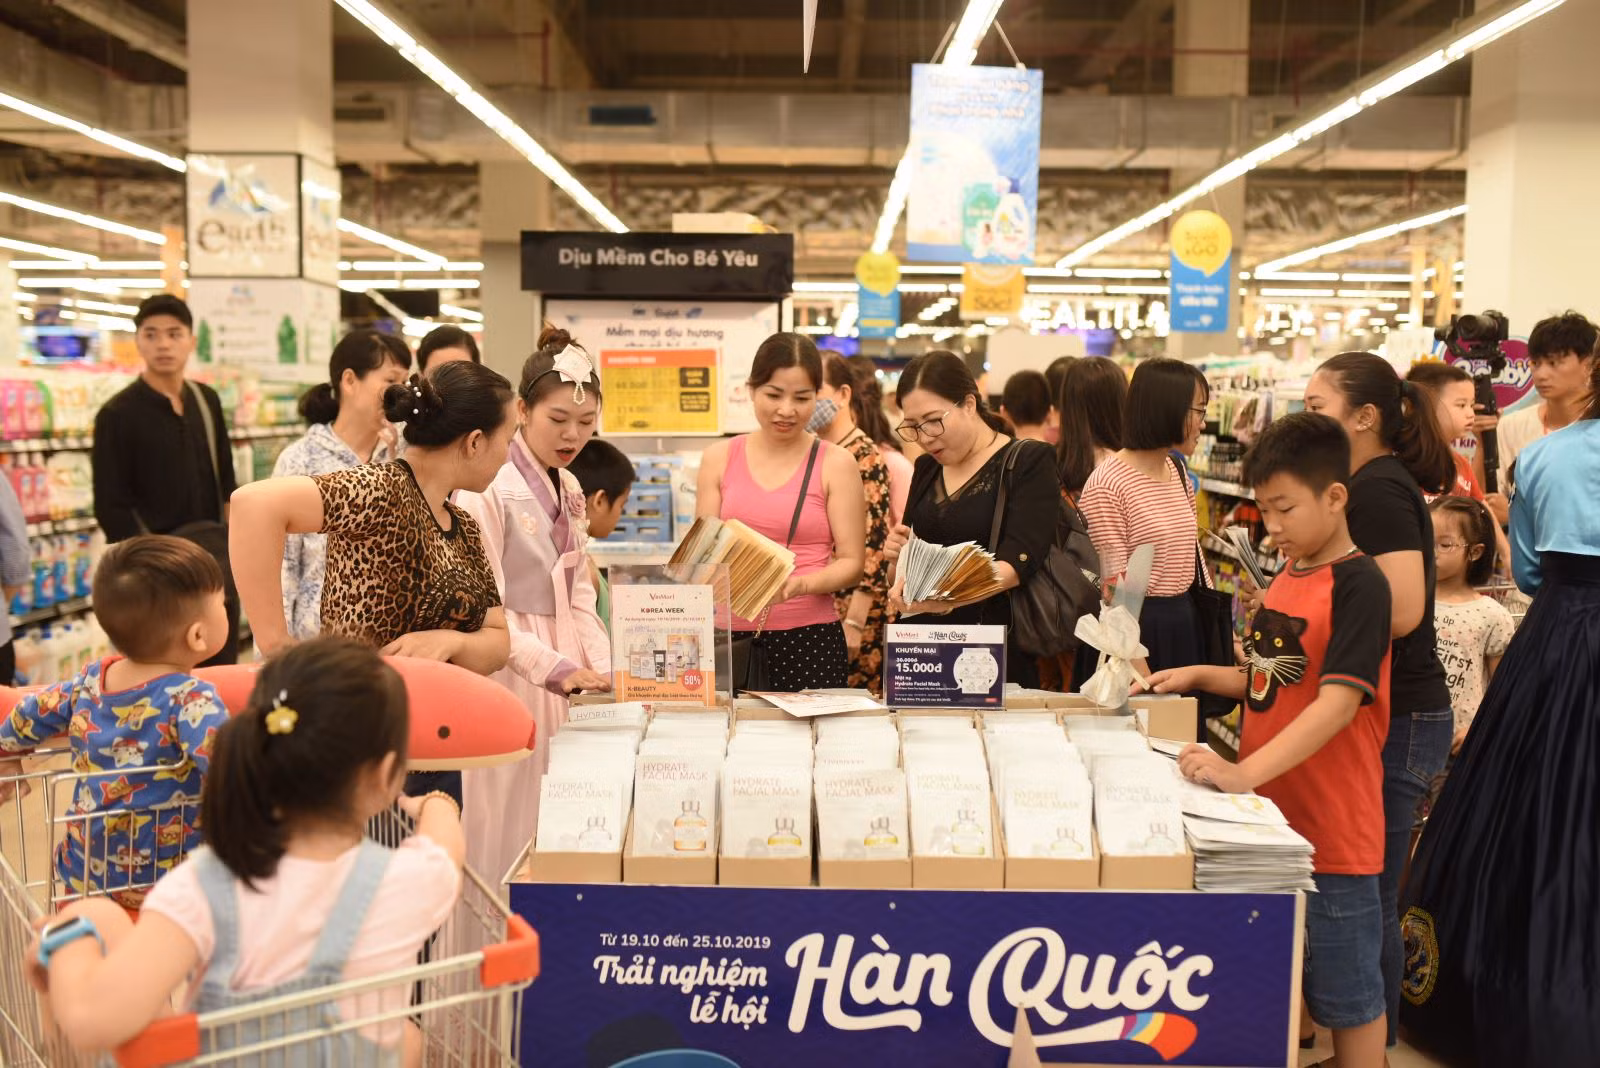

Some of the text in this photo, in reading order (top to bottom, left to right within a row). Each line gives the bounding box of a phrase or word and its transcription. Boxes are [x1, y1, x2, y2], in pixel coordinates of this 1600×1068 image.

[558, 246, 758, 269] Dịu Mềm Cho Bé Yêu
[1437, 635, 1459, 648] have
[923, 647, 937, 655] MẠI
[895, 662, 943, 673] 15.000đ
[684, 675, 701, 685] 50%
[643, 762, 687, 772] HYDRATE
[643, 771, 709, 781] FACIAL MASK
[733, 776, 780, 787] HYDRATE
[825, 777, 872, 788] HYDRATE
[733, 786, 801, 797] FACIAL MASK
[825, 785, 896, 799] FACIAL MASK
[600, 933, 771, 949] Từ 19.10 đến 25.10.2019
[593, 954, 768, 994] Trải nghiệm
[785, 926, 1214, 1049] Hàn Quốc
[690, 990, 770, 1030] lễ hội
